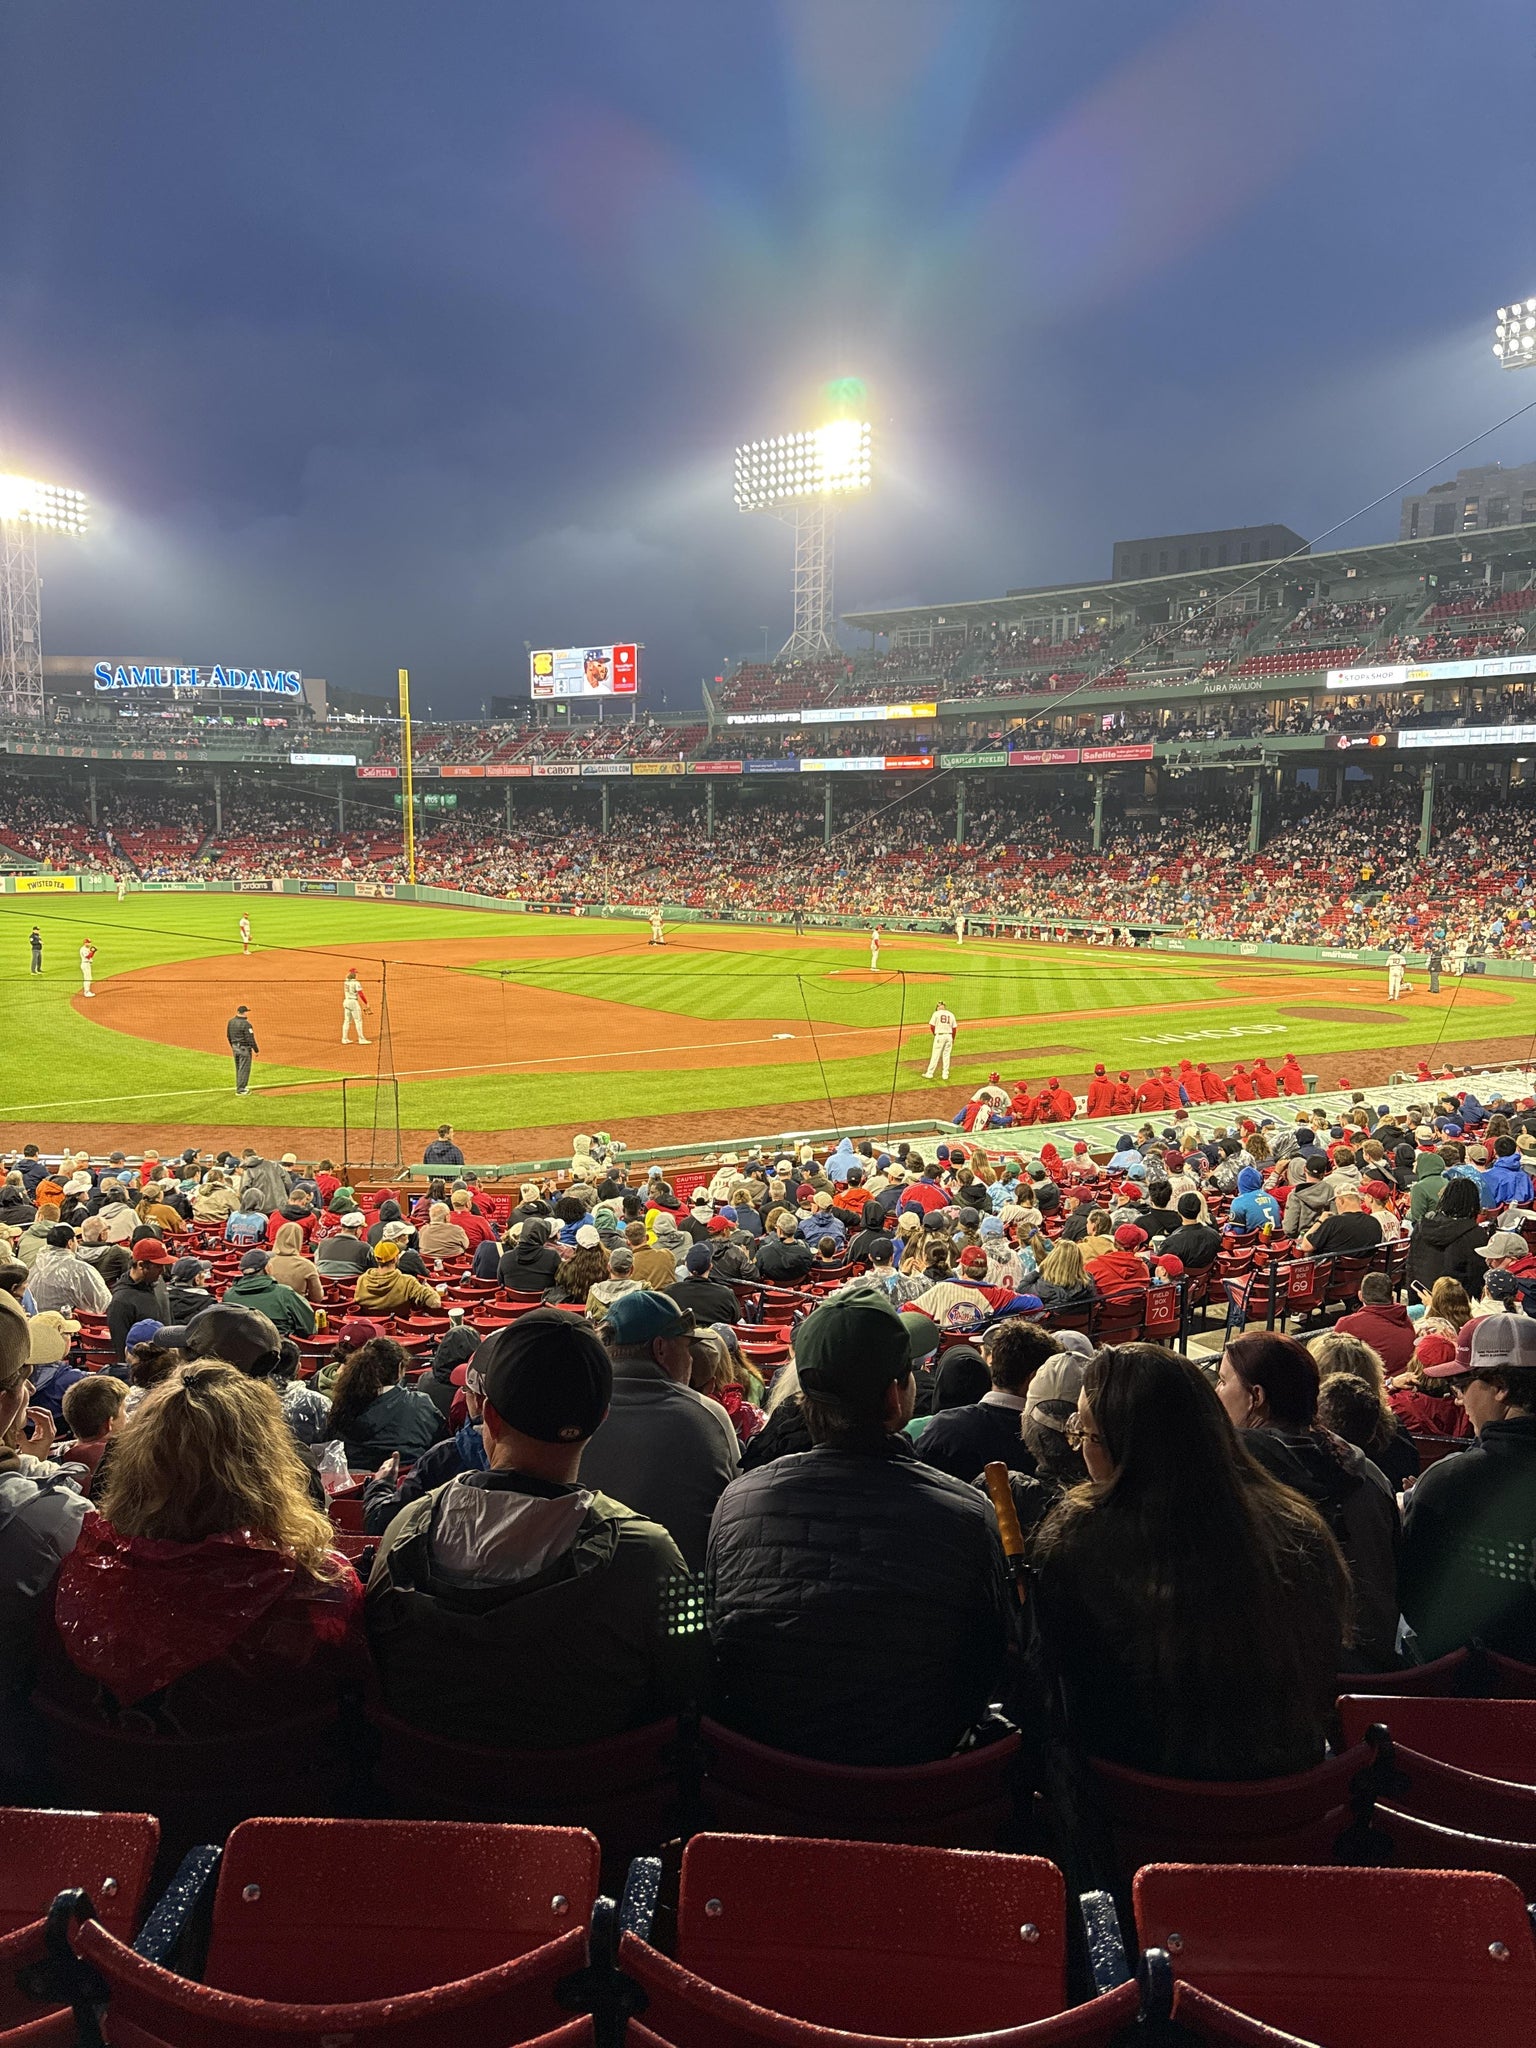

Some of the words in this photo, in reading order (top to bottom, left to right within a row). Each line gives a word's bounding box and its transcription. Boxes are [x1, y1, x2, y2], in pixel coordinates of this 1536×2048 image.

[94, 661, 205, 690] SAMUEL
[207, 664, 301, 696] ADAMS
[1229, 681, 1263, 690] PAVILION
[978, 755, 1005, 764] PICKLES
[1023, 754, 1042, 762] Ninety
[1084, 751, 1117, 760] Safelite
[27, 880, 53, 890] TWISTED
[54, 880, 65, 889] TEA
[940, 1014, 950, 1024] 81
[987, 1096, 1001, 1108] 38
[1262, 1207, 1276, 1230] 5
[1292, 1280, 1308, 1292] 69
[1152, 1291, 1170, 1299] FIELD
[1154, 1298, 1167, 1306] BOX
[1151, 1306, 1169, 1320] 70
